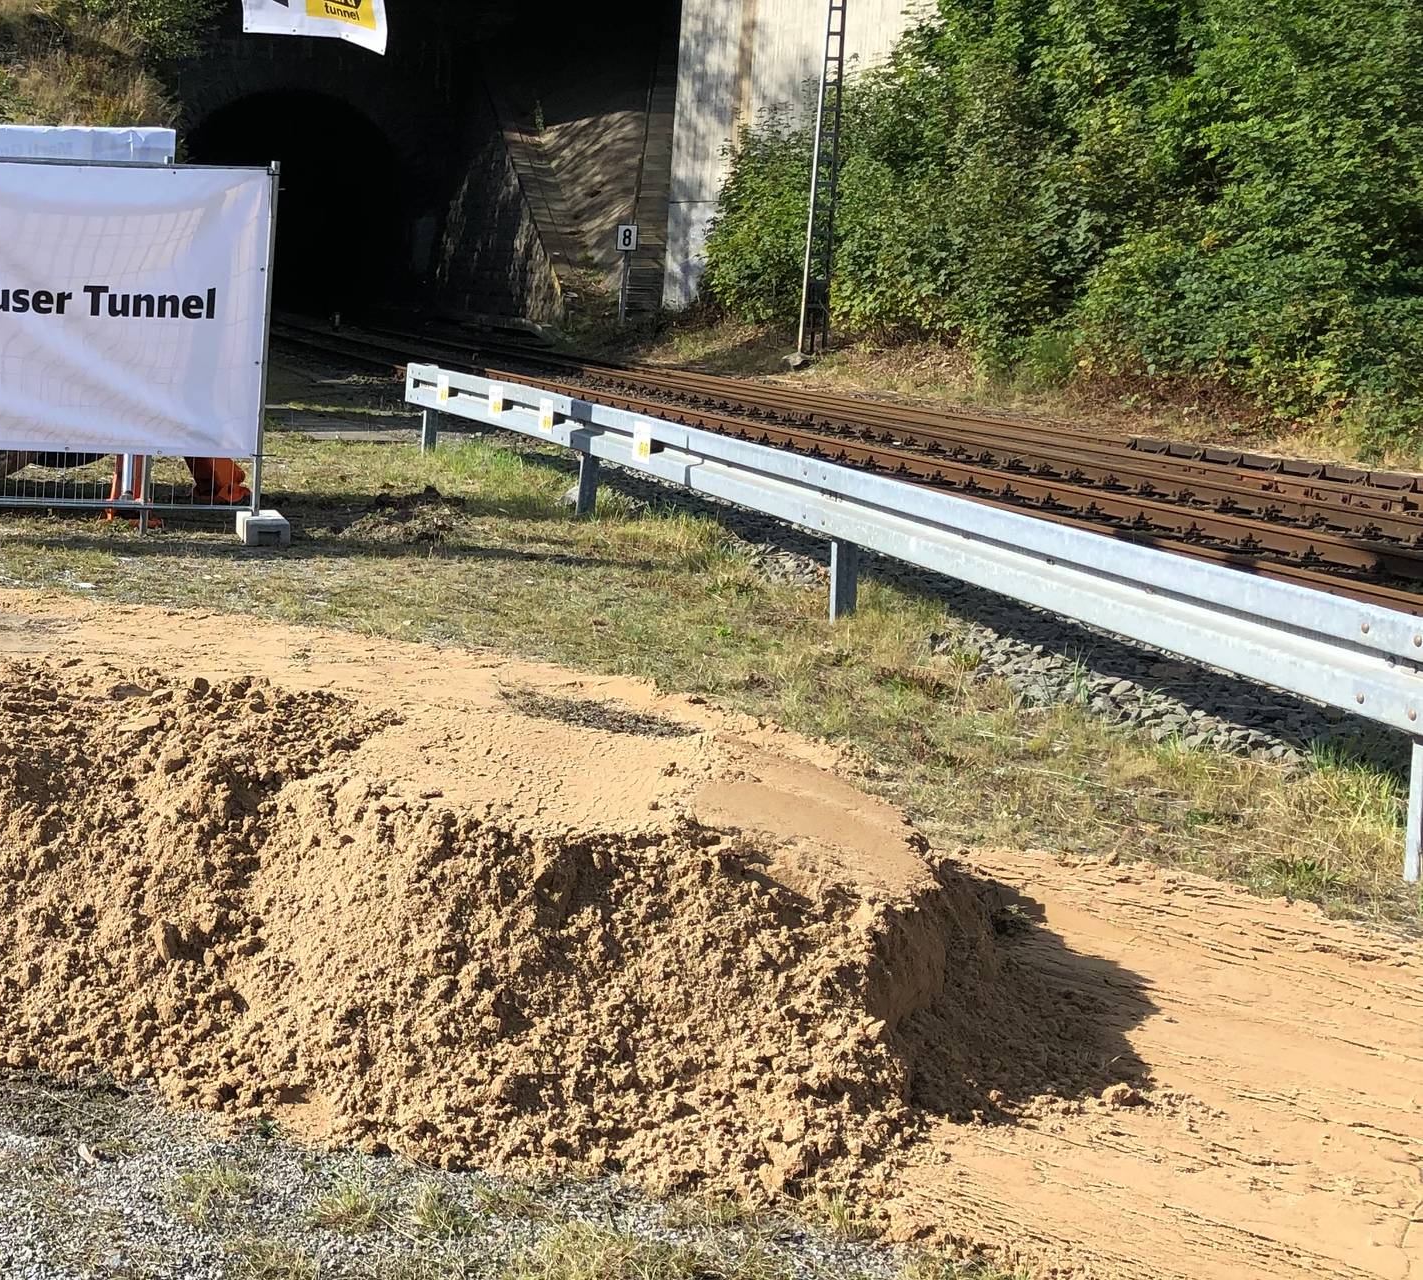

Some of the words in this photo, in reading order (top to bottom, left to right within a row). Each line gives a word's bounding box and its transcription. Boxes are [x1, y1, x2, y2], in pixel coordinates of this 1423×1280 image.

[324, 2, 360, 21] tunnel
[622, 228, 632, 247] 8
[83, 284, 217, 319] Tunnel
